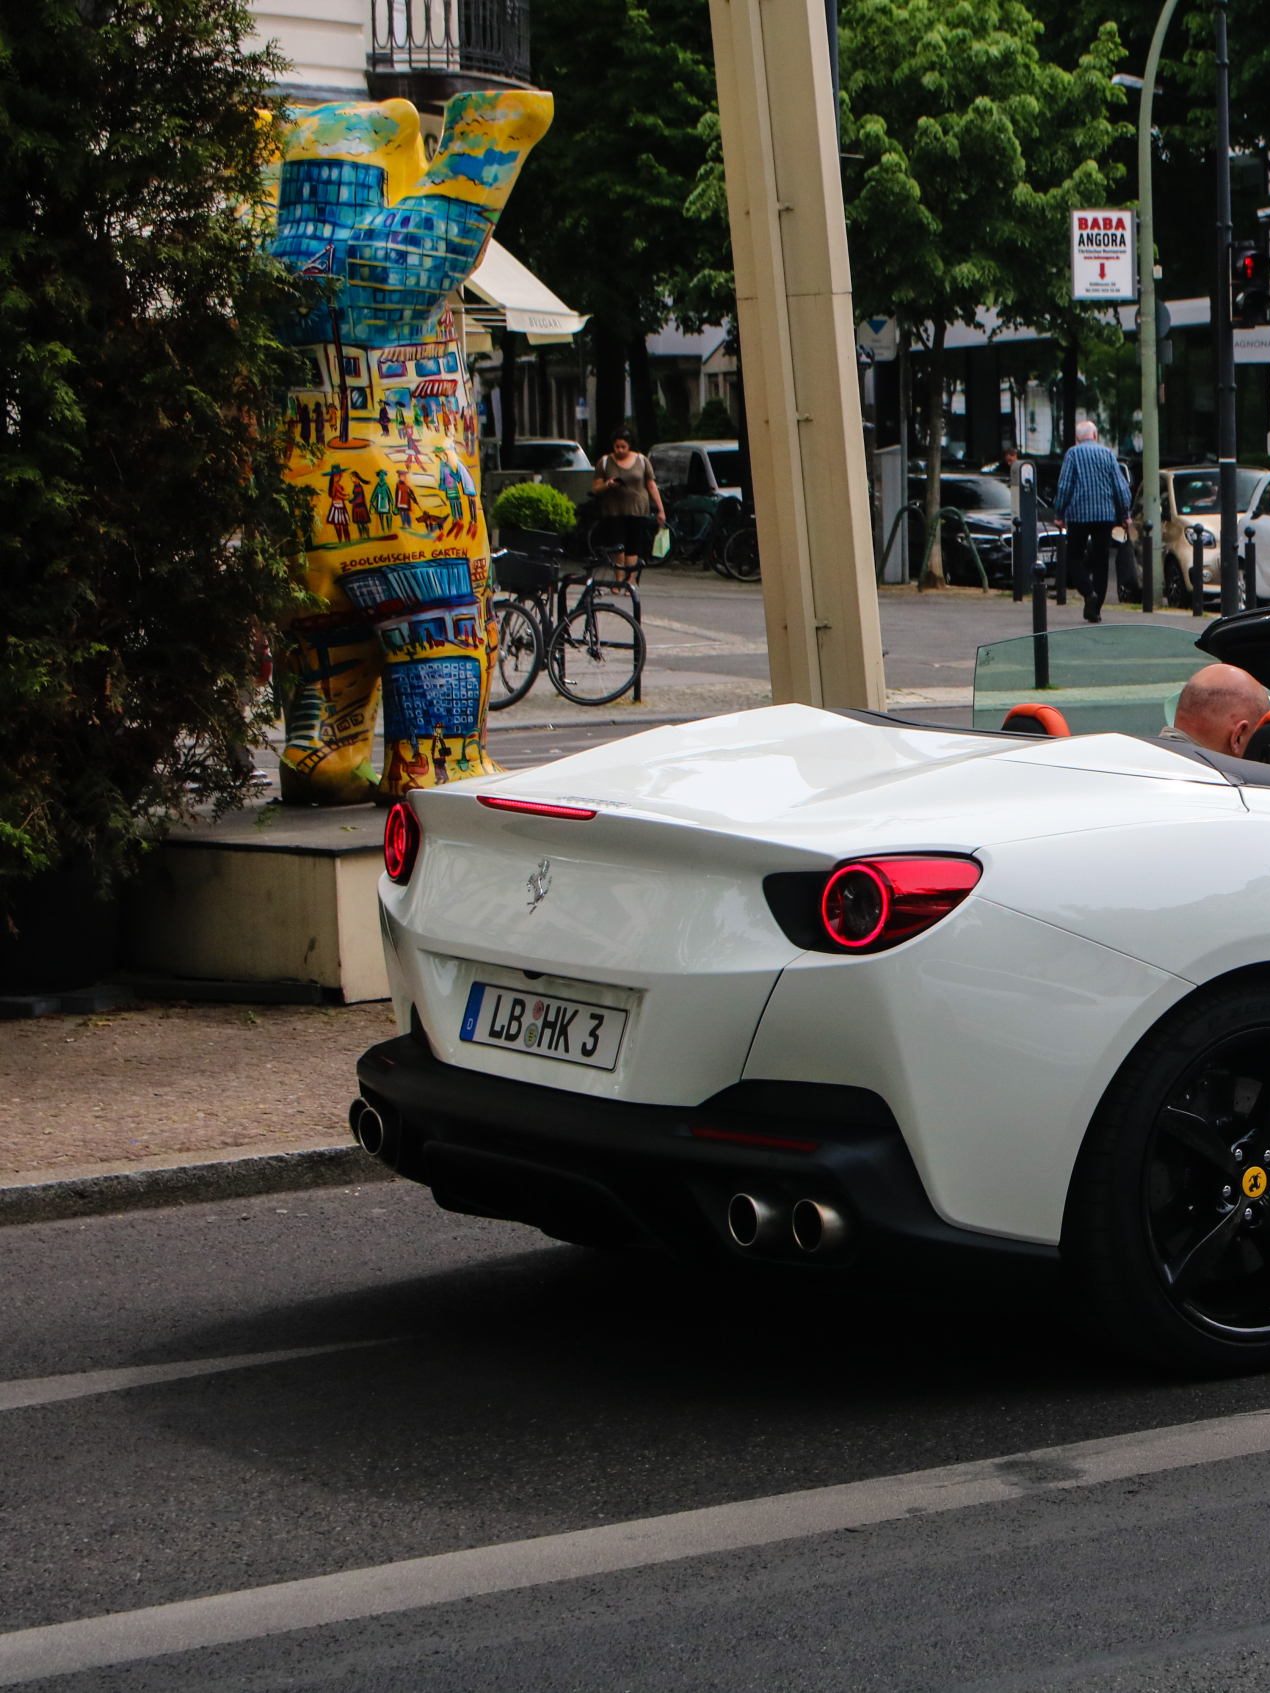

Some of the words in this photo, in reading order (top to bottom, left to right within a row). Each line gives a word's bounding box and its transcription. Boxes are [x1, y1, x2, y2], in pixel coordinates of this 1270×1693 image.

[1078, 217, 1126, 231] BABA
[1078, 232, 1126, 247] ANGORA
[340, 551, 426, 572] ZOOLOGISCHER
[432, 548, 468, 559] GARTEN
[488, 994, 526, 1042] LB
[537, 1004, 579, 1053] HK
[581, 1013, 604, 1057] 3
